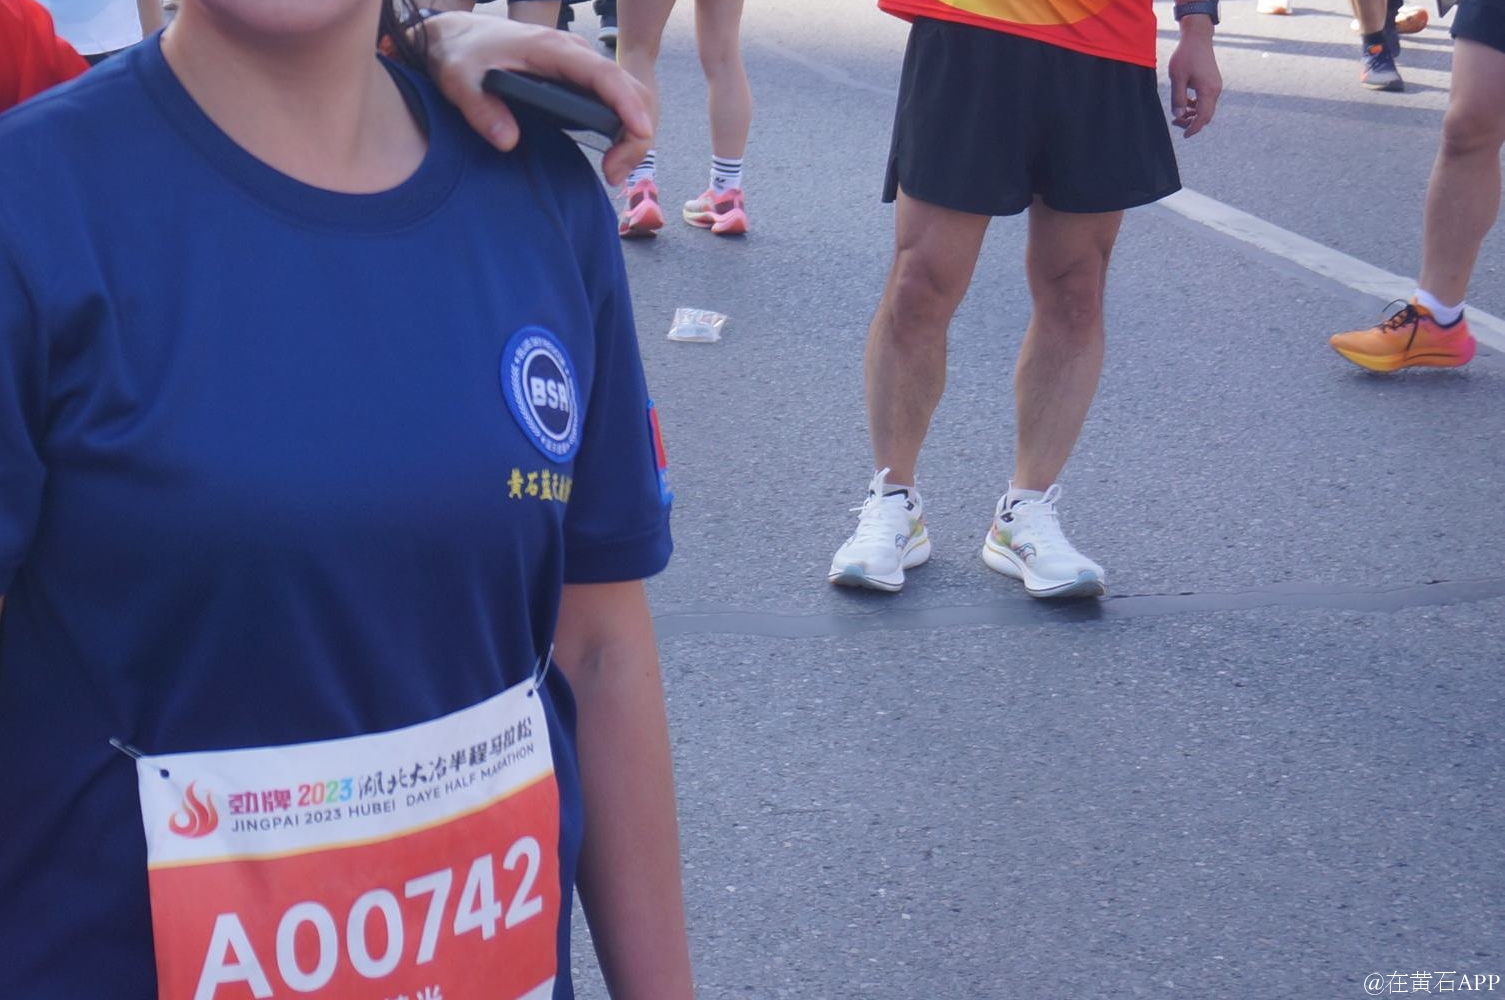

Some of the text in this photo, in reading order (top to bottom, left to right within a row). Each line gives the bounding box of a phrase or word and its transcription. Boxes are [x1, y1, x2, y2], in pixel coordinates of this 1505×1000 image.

[228, 716, 532, 815] 劲牌 2023 湖北大冶半程马拉松
[232, 743, 534, 833] JINGPAI 2023 HUBEI DAYE HALF MARATHON
[195, 835, 543, 1000] A00742
